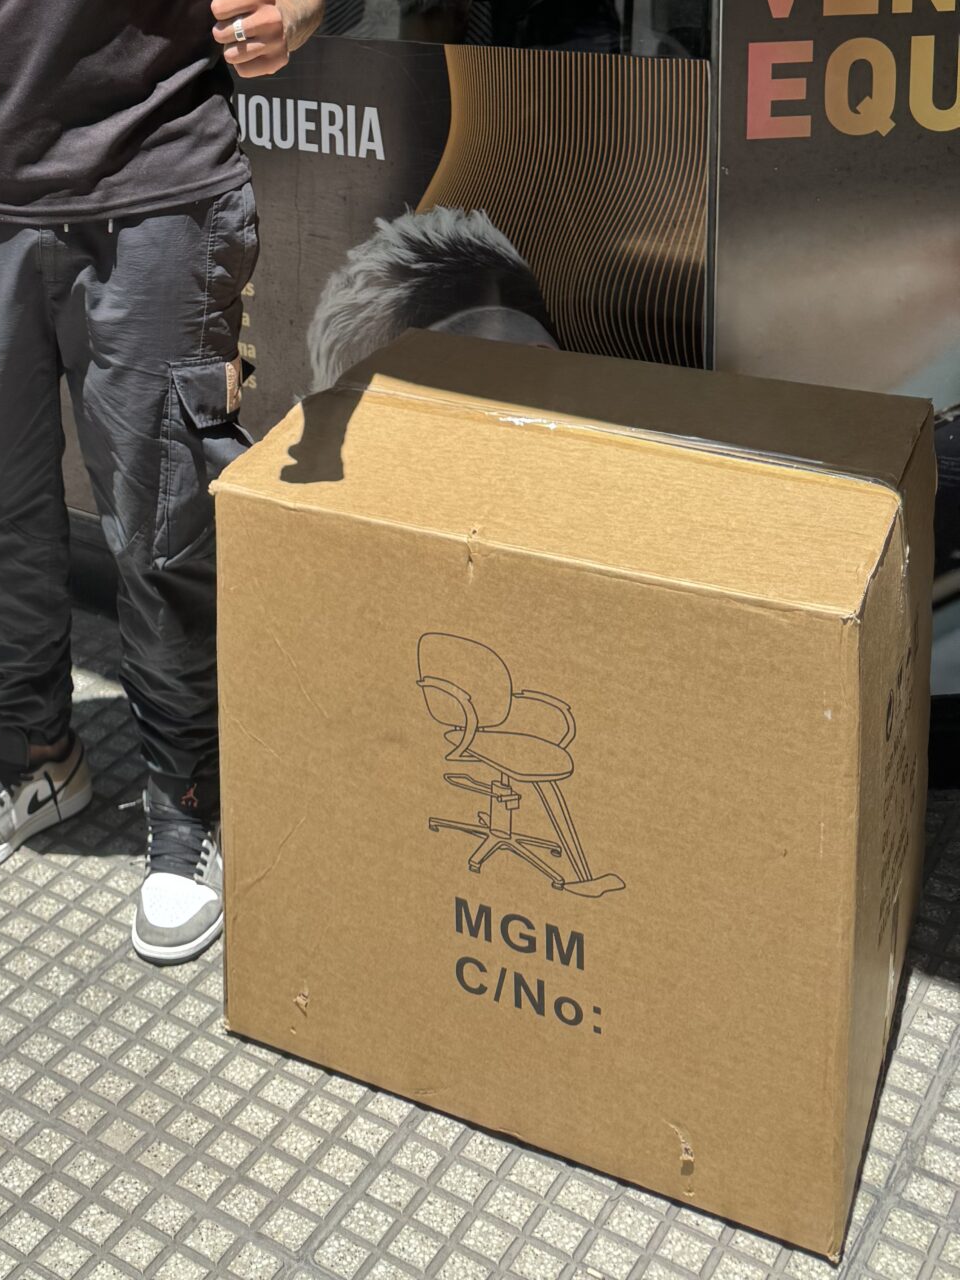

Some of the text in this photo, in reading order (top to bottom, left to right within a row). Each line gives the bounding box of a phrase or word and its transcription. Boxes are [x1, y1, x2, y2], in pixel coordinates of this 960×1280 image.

[746, 34, 960, 140] EQU
[455, 896, 585, 971] MGM
[455, 956, 602, 1035] C/No:
